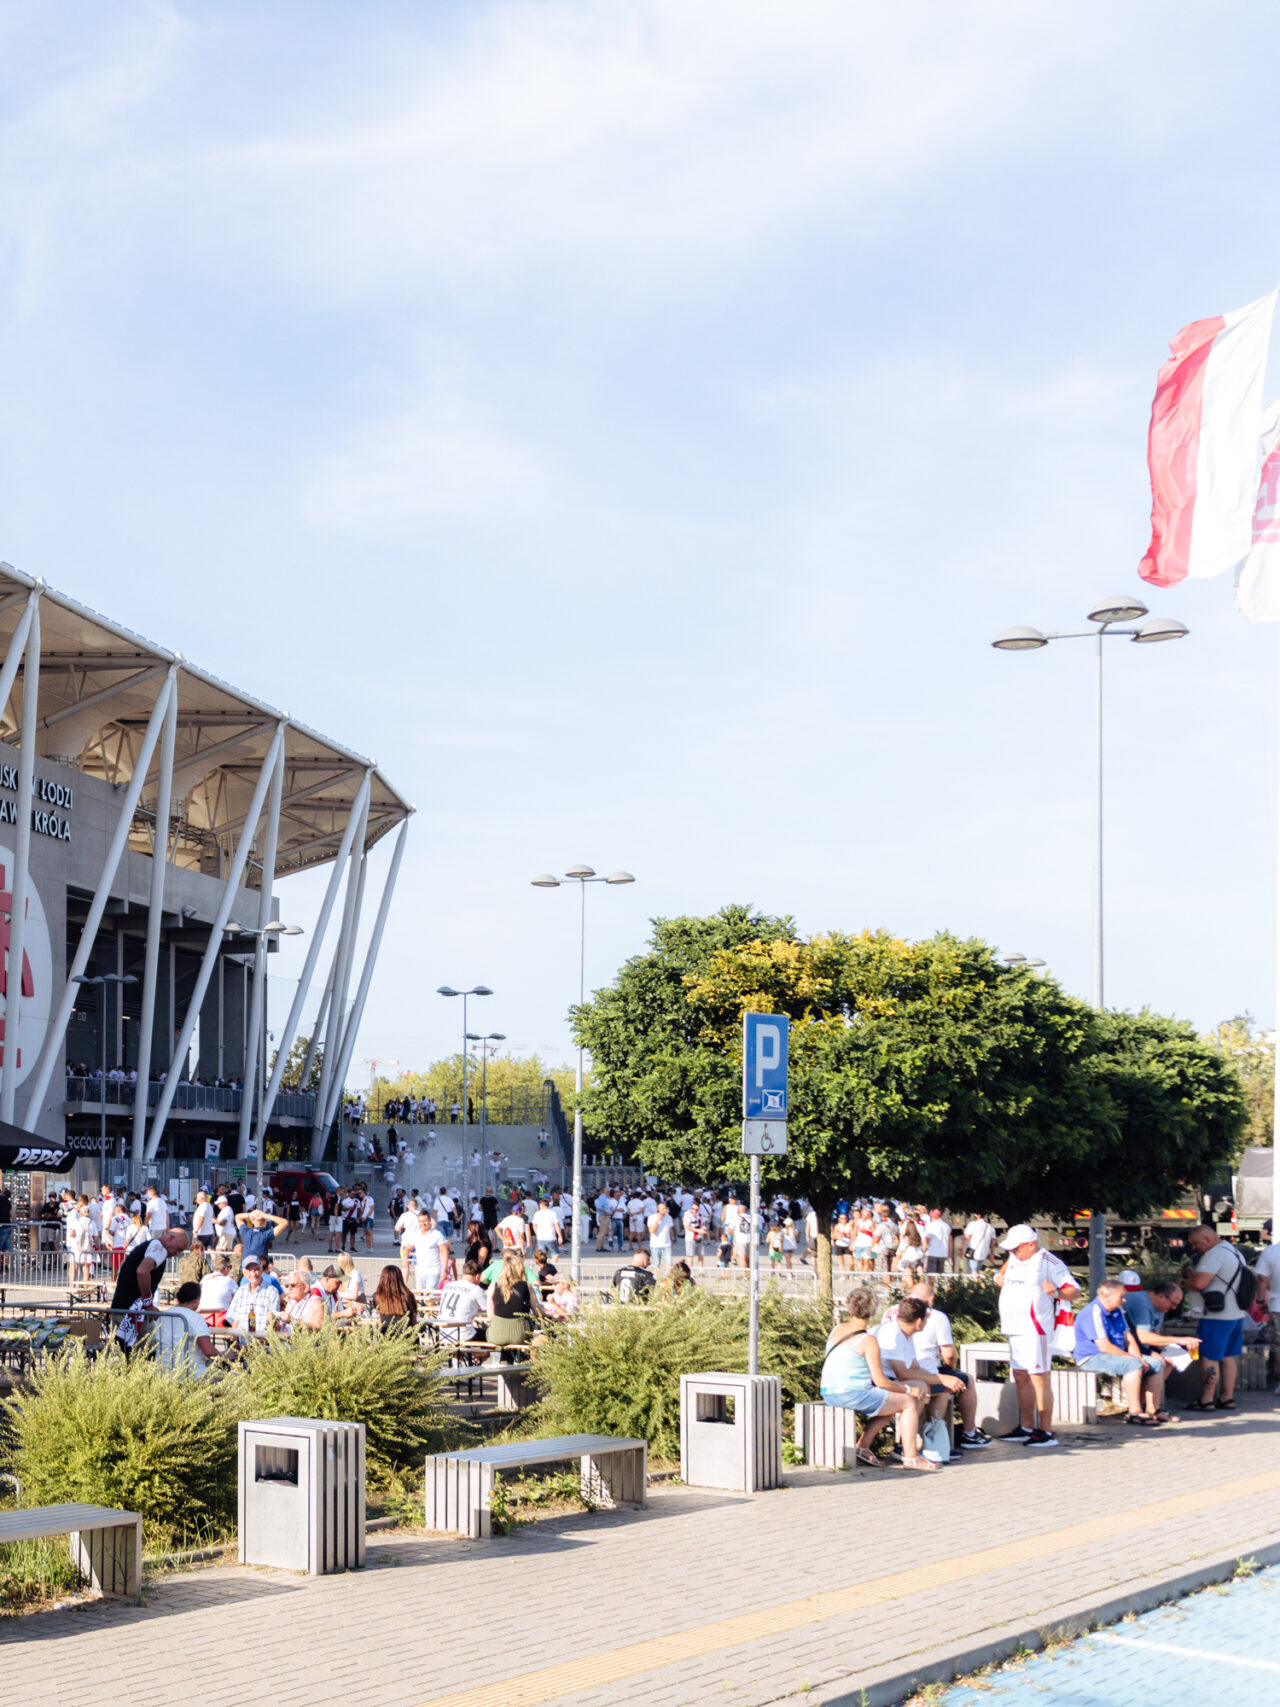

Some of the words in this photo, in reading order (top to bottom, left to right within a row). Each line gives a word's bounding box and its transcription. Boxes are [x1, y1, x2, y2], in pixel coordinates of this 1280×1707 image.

[40, 778, 73, 810] ŁODZI
[34, 810, 72, 842] KRÓLA
[755, 1023, 780, 1088] P
[12, 1147, 70, 1167] PEPSI
[440, 1292, 461, 1318] 14
